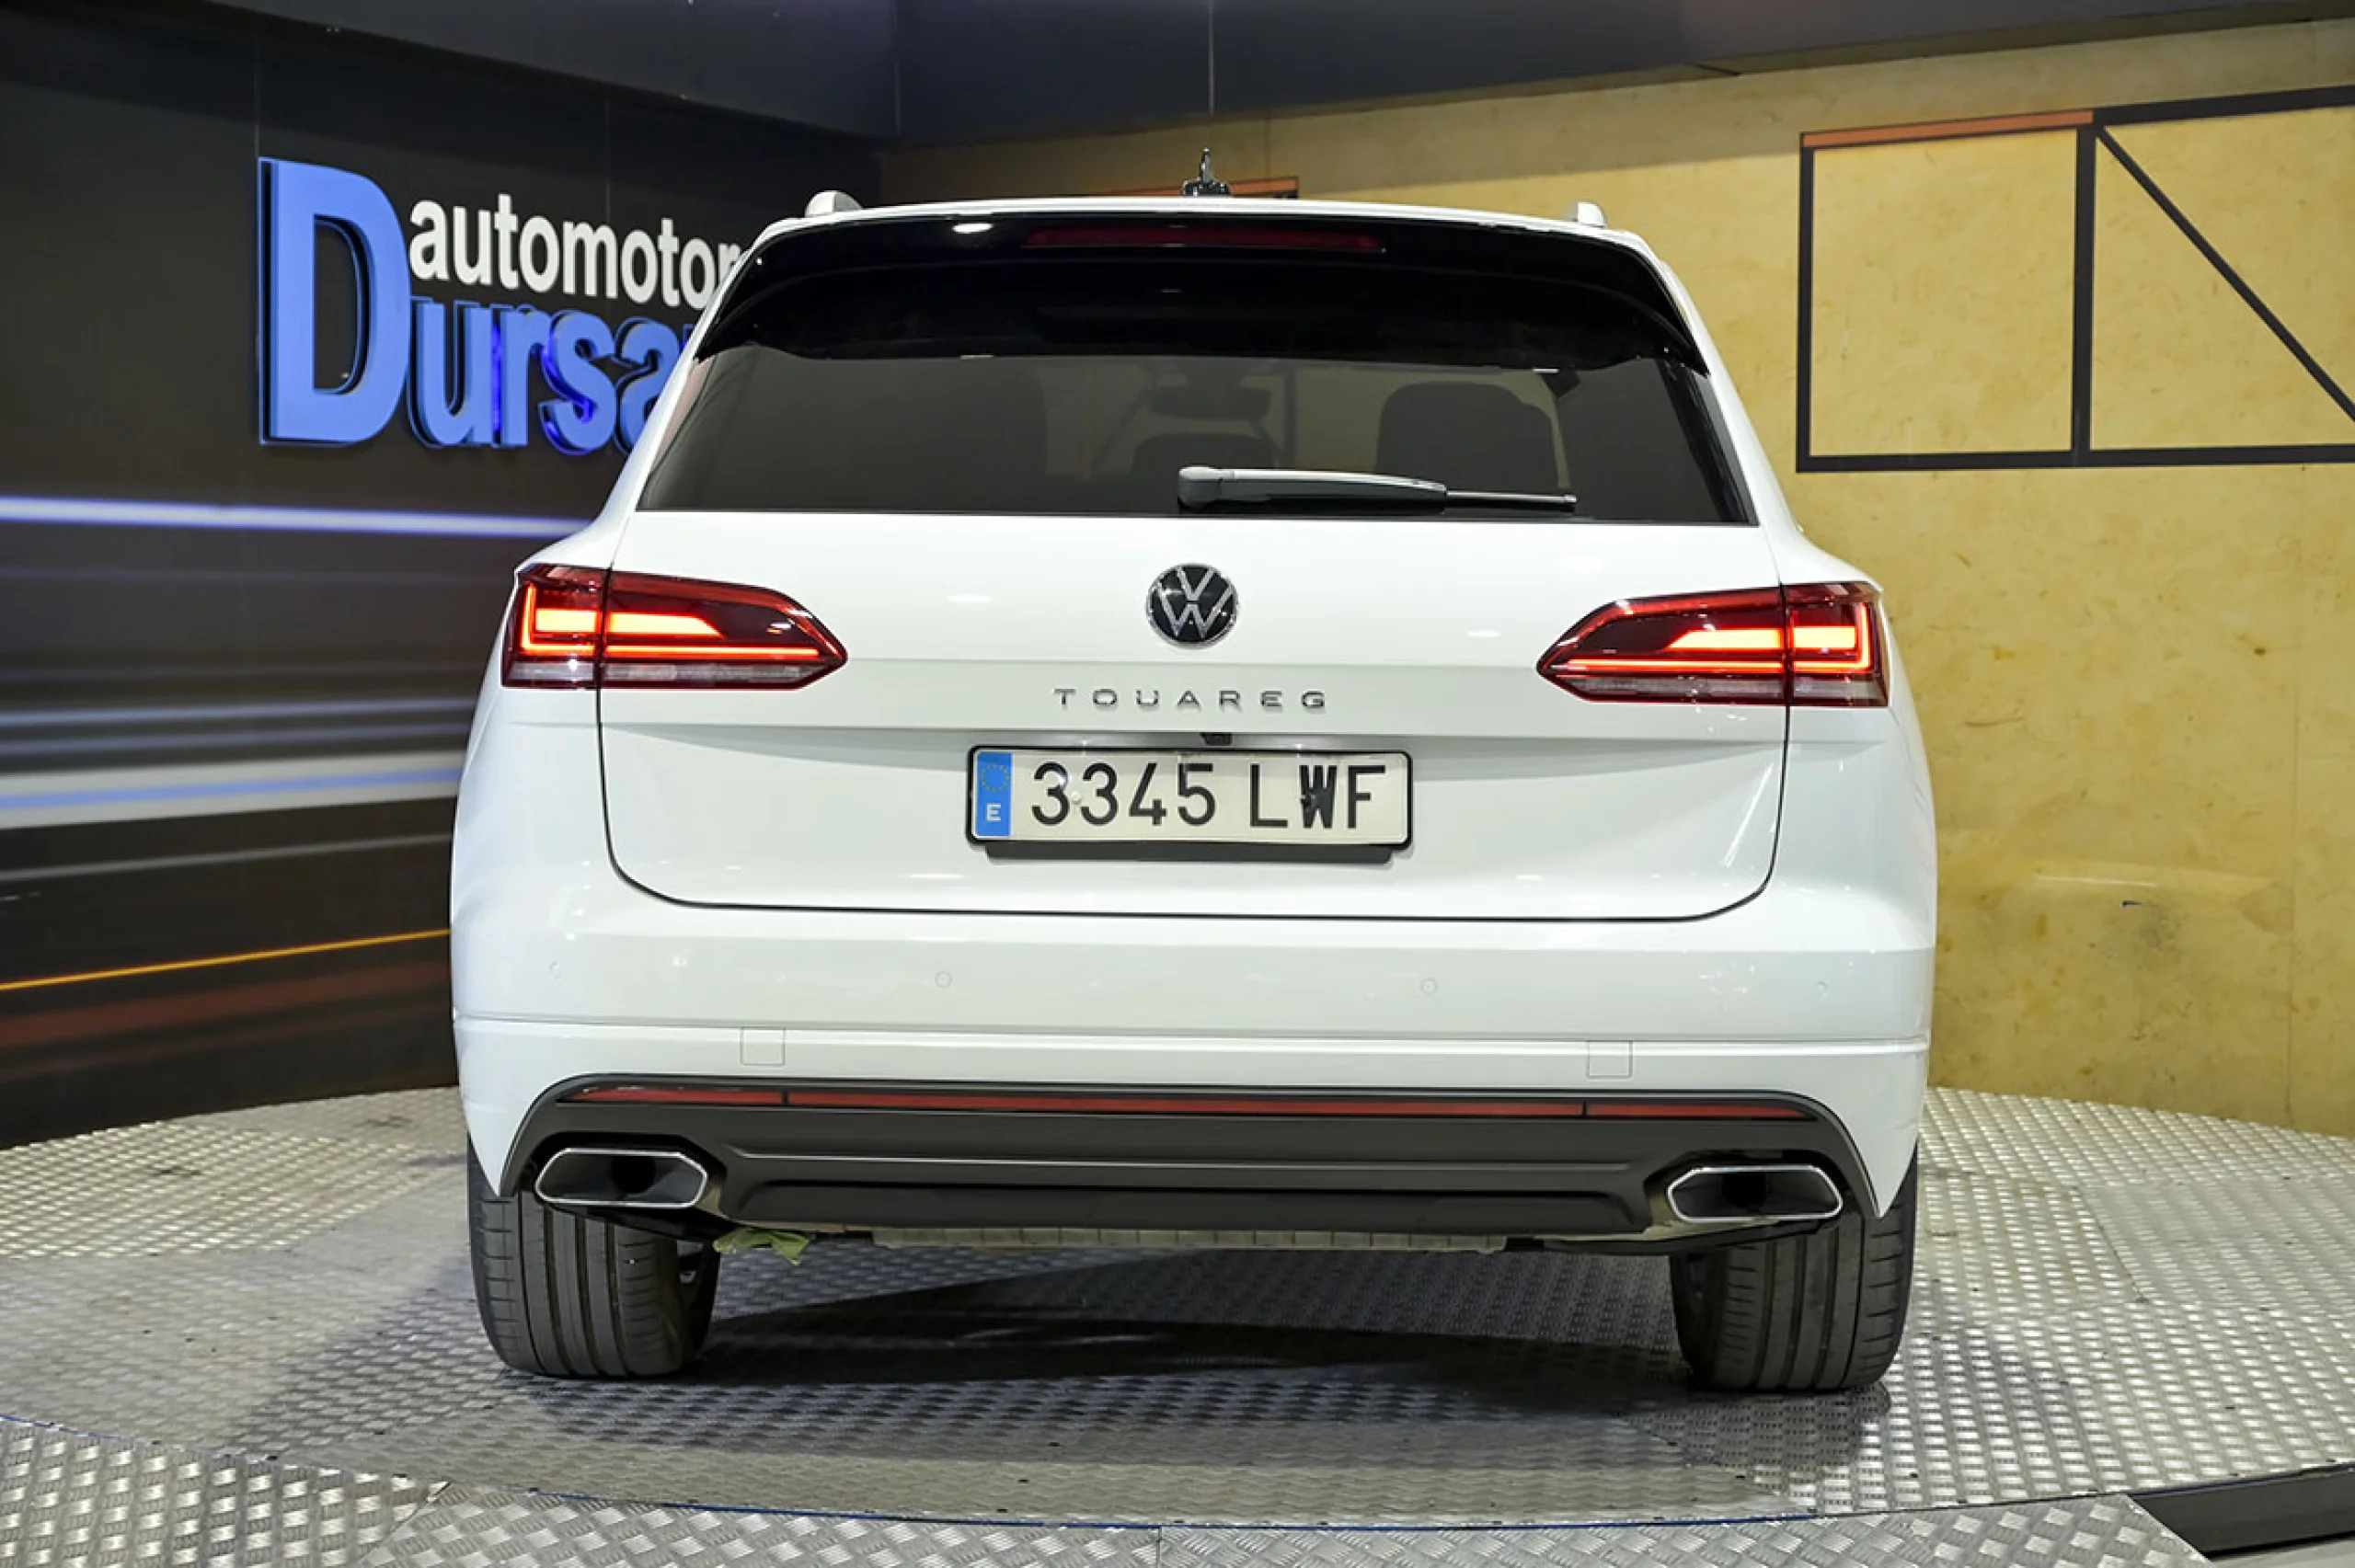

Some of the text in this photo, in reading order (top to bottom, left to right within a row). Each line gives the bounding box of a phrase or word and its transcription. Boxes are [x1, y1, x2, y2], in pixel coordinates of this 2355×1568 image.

[258, 156, 693, 455] Dursa
[1053, 688, 1326, 708] TOUAREG
[986, 803, 1002, 821] E
[1031, 761, 1386, 829] 3345 LWF
